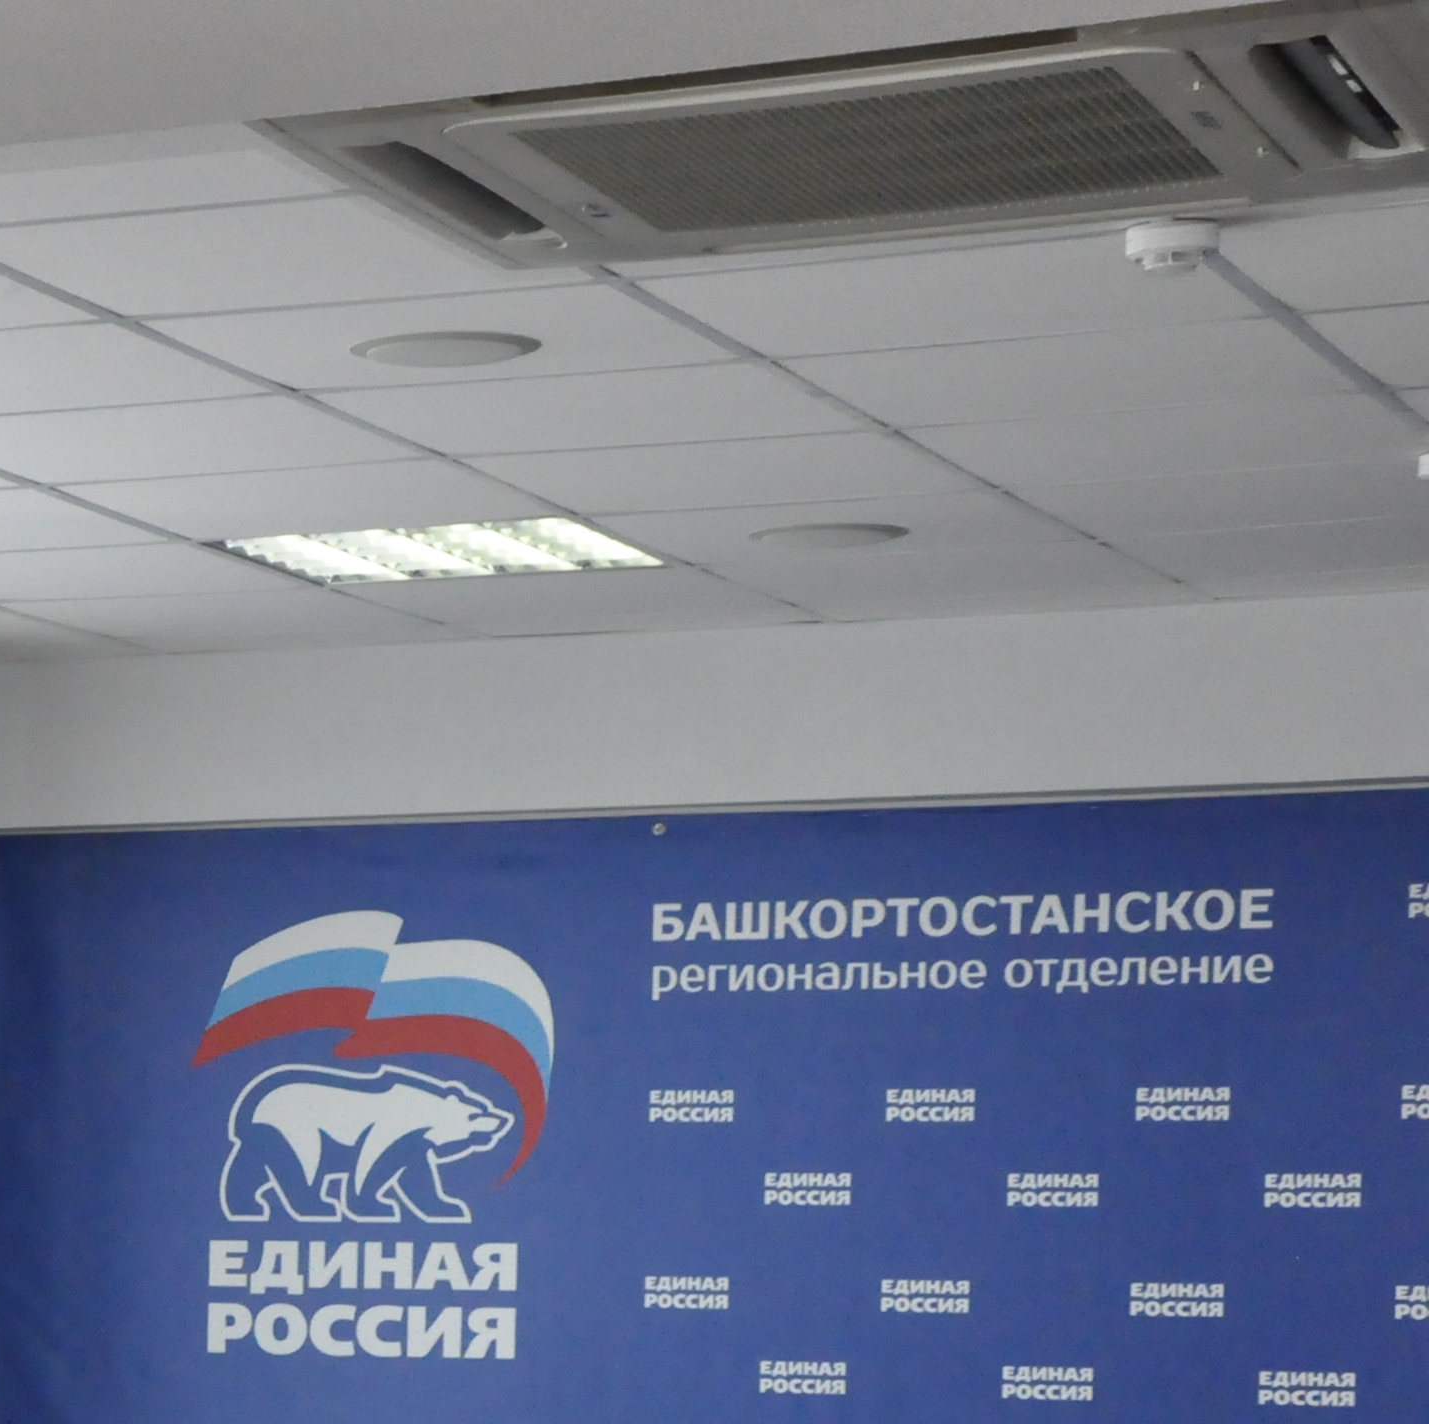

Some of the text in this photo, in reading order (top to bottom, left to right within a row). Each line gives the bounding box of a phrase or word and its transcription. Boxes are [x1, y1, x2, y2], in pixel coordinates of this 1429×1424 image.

[651, 888, 1275, 942] БАШКОРТОСТАНСКОЕ
[651, 953, 1275, 1001] региональное отделение
[648, 1089, 735, 1107] ЕДИНАЯ
[885, 1088, 976, 1106] ЕДИНАЯ
[1135, 1086, 1232, 1105] ЕДИНАЯ
[648, 1106, 735, 1123] РОССИЯ
[885, 1105, 976, 1123] РОССИЯ
[1134, 1104, 1231, 1122] РОССИЯ
[763, 1171, 853, 1190] ЕДИНАЯ
[1006, 1172, 1100, 1191] ЕДИНАЯ
[1264, 1172, 1363, 1192] ЕДИНАЯ
[763, 1189, 852, 1207] РОССИЯ
[1006, 1190, 1100, 1208] РОССИЯ
[1263, 1191, 1362, 1209] РОССИЯ
[207, 1239, 519, 1296] ЕДИНАЯ
[643, 1275, 730, 1293] ЕДИНАЯ
[880, 1278, 971, 1297] ЕДИНАЯ
[1129, 1282, 1226, 1300] ЕДИНАЯ
[643, 1292, 730, 1310] РОССИЯ
[879, 1296, 971, 1314] РОССИЯ
[1128, 1299, 1225, 1318] РОССИЯ
[206, 1301, 518, 1360] РОССИЯ
[758, 1359, 847, 1378] ЕДИНАЯ
[1001, 1365, 1095, 1383] ЕДИНАЯ
[758, 1377, 847, 1396] РОССИЯ
[1258, 1370, 1357, 1389] ЕДИНАЯ
[1000, 1382, 1094, 1402] РОССИЯ
[1257, 1388, 1357, 1408] РОССИЯ
